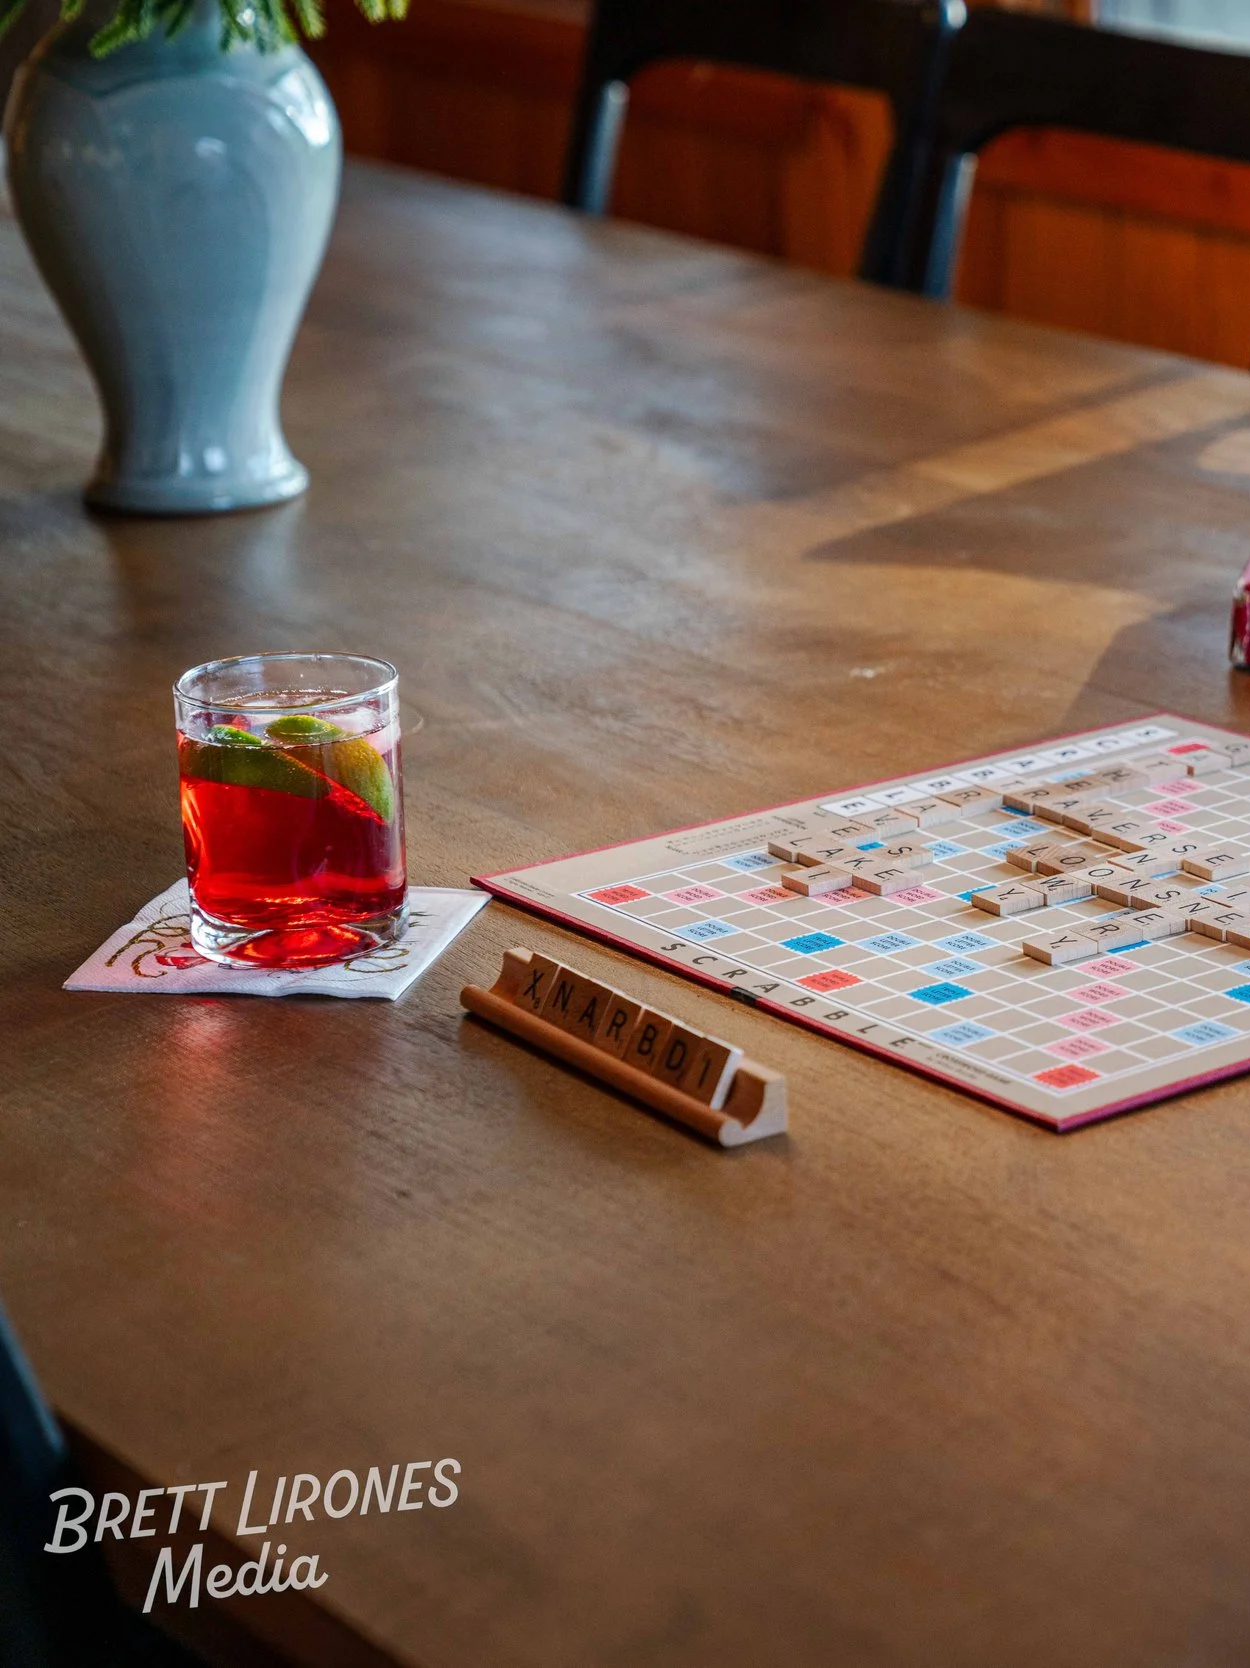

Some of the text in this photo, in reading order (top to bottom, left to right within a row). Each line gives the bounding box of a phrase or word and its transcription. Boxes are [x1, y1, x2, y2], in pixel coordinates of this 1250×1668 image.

[674, 893, 692, 901] SCORE
[692, 888, 713, 897] DOUBLE
[749, 893, 767, 901] SCORE
[759, 891, 776, 899] WORD
[766, 888, 788, 898] DOUBLE
[833, 891, 850, 899] WORD
[840, 889, 862, 898] DOUBLE
[913, 889, 935, 898] DOUBLE
[823, 893, 841, 902] SCORE
[896, 894, 915, 902] SCORE
[687, 928, 706, 937] SCORE
[697, 926, 716, 935] LETTER
[706, 923, 727, 933] DOUBLE
[880, 938, 899, 947] LETTER
[888, 935, 911, 945] DOUBLE
[956, 938, 975, 947] LETTER
[963, 935, 987, 945] DOUBLE
[870, 941, 889, 949] SCORE
[946, 941, 965, 949] SCORE
[934, 965, 954, 974] SCORE
[944, 963, 964, 972] LETTER
[952, 960, 976, 970] DOUBLE
[1089, 965, 1110, 974] SCORE
[1100, 963, 1119, 972] WORD
[1107, 960, 1131, 970] DOUBLE
[661, 942, 916, 1049] SCRABBLE
